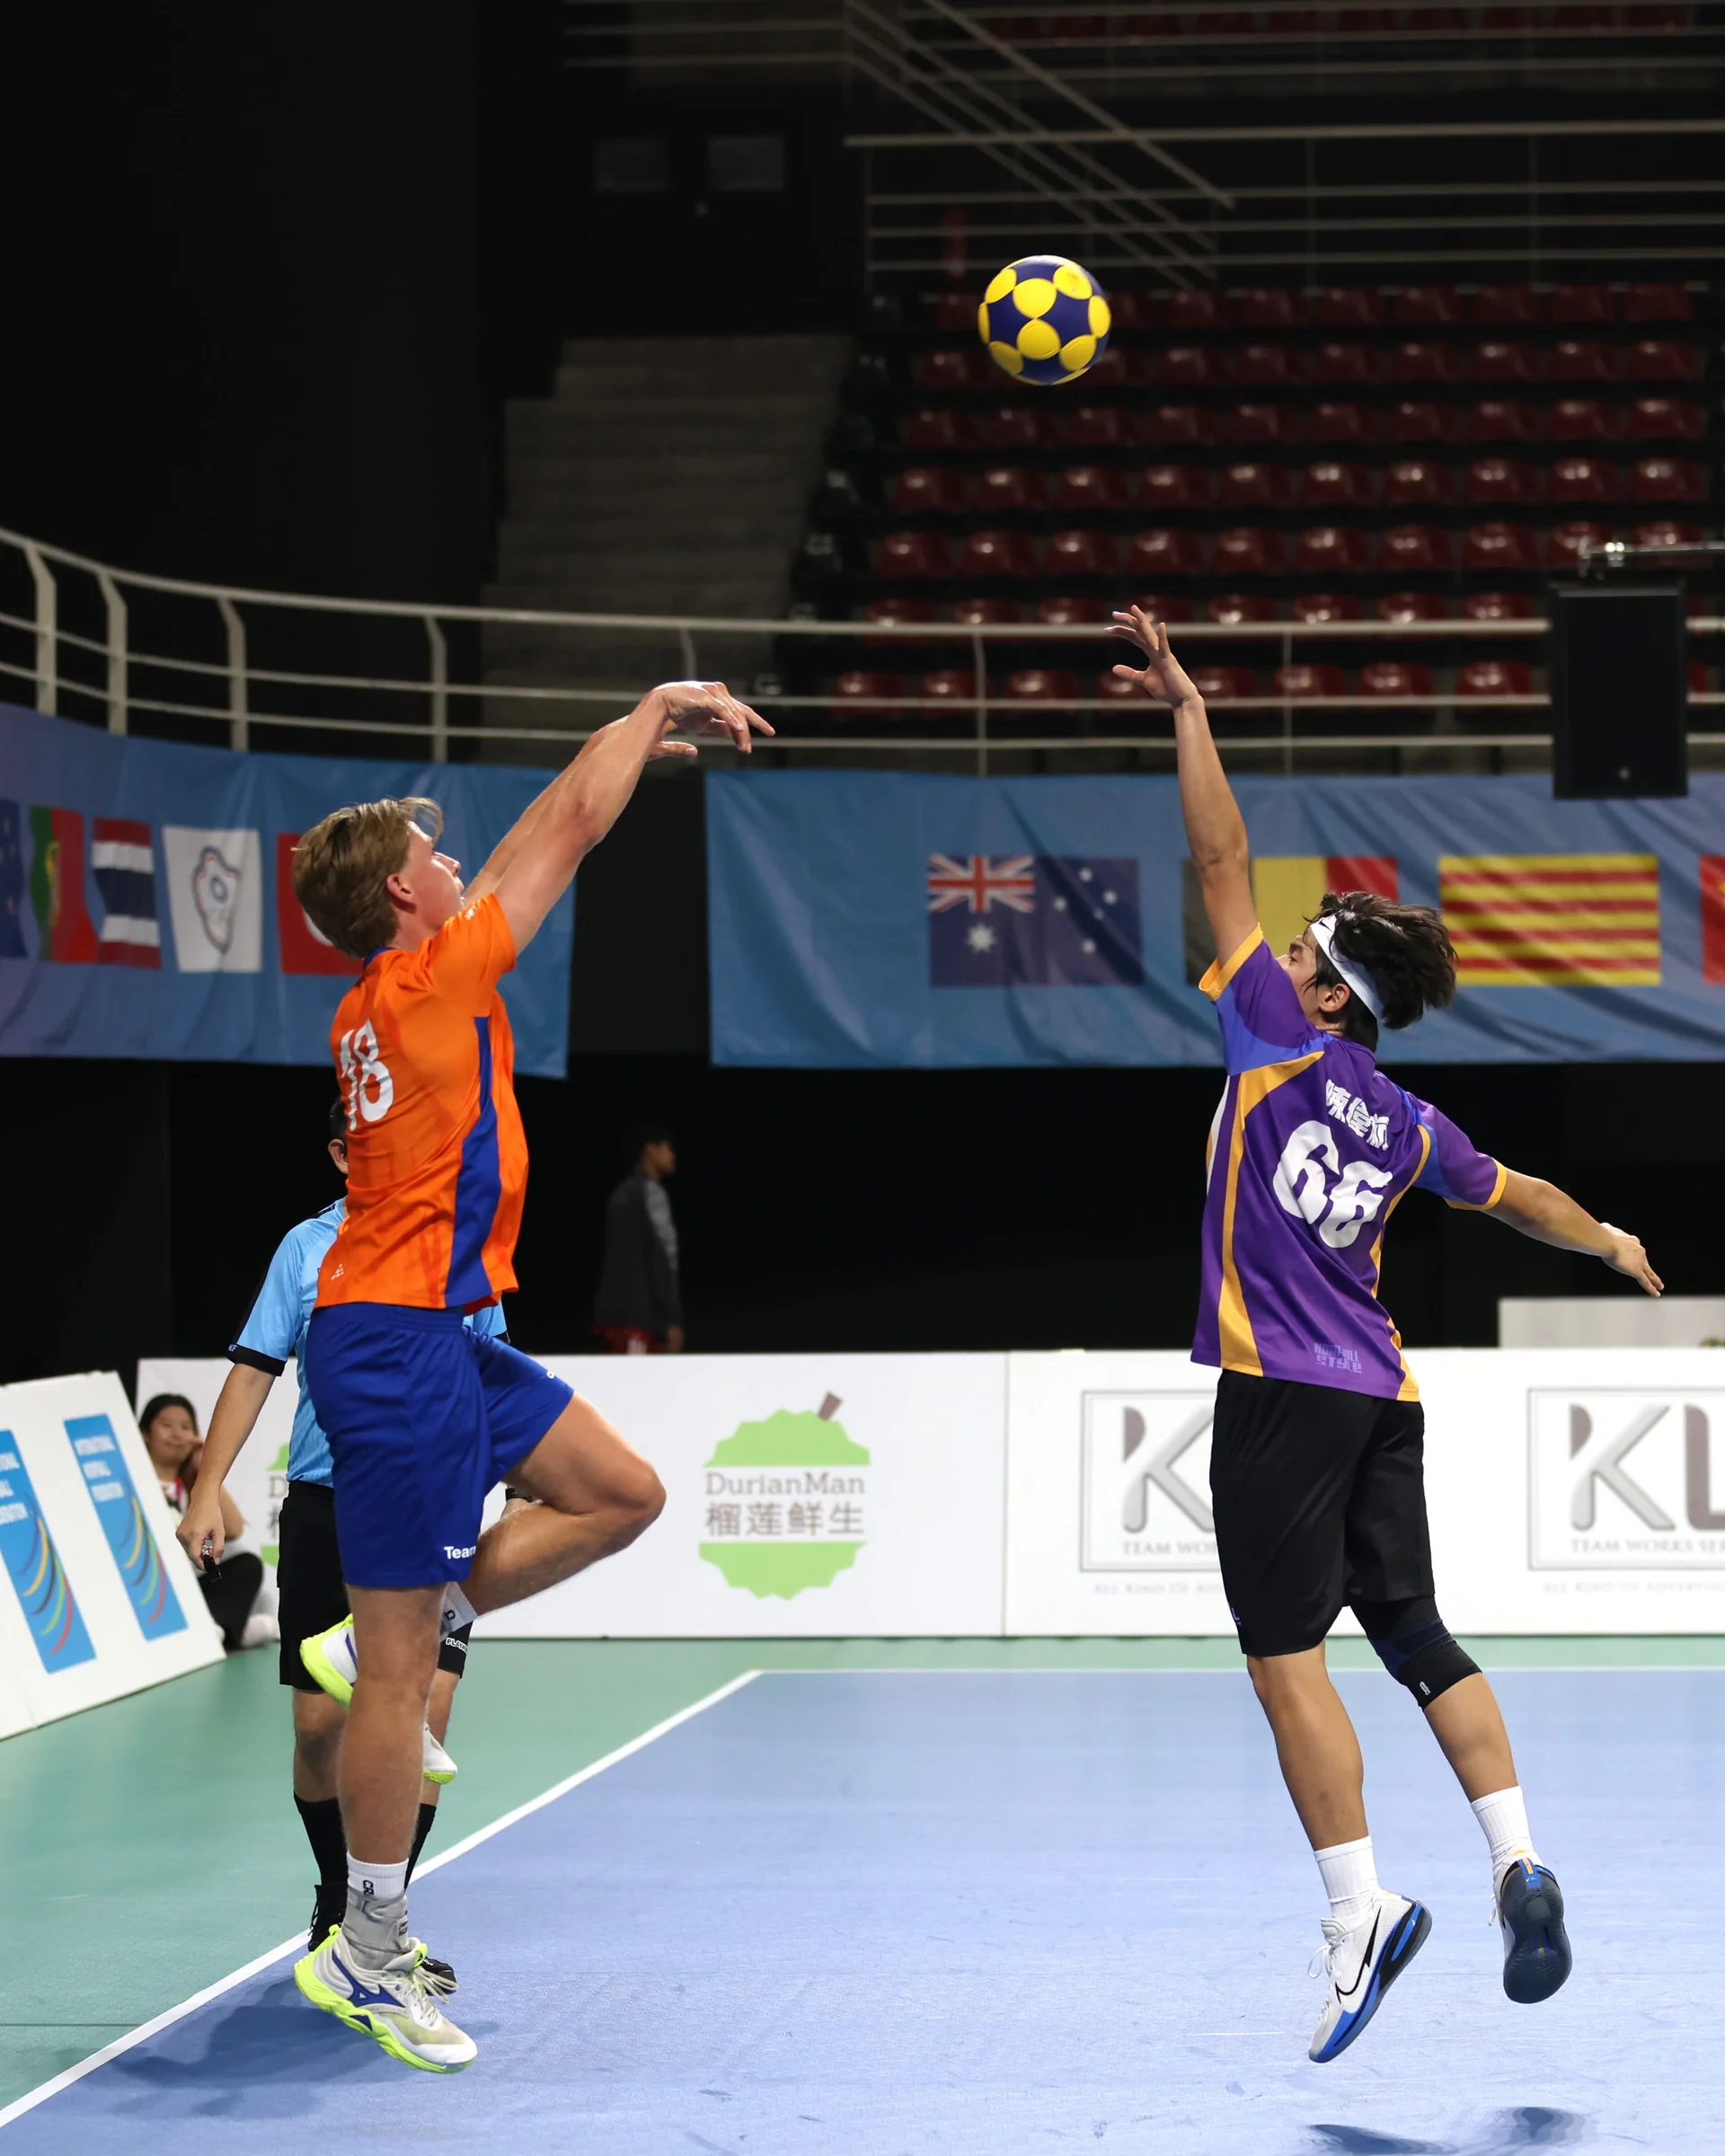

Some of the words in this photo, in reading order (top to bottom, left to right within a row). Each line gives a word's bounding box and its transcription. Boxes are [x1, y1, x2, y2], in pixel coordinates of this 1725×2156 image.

[341, 1019, 394, 1132] 18
[1272, 1120, 1393, 1249] 66
[705, 1471, 865, 1497] DurianMan
[703, 1500, 865, 1536] 榴莲鲜生
[1121, 1541, 1172, 1557] TEAM
[1570, 1538, 1621, 1554] TEAM
